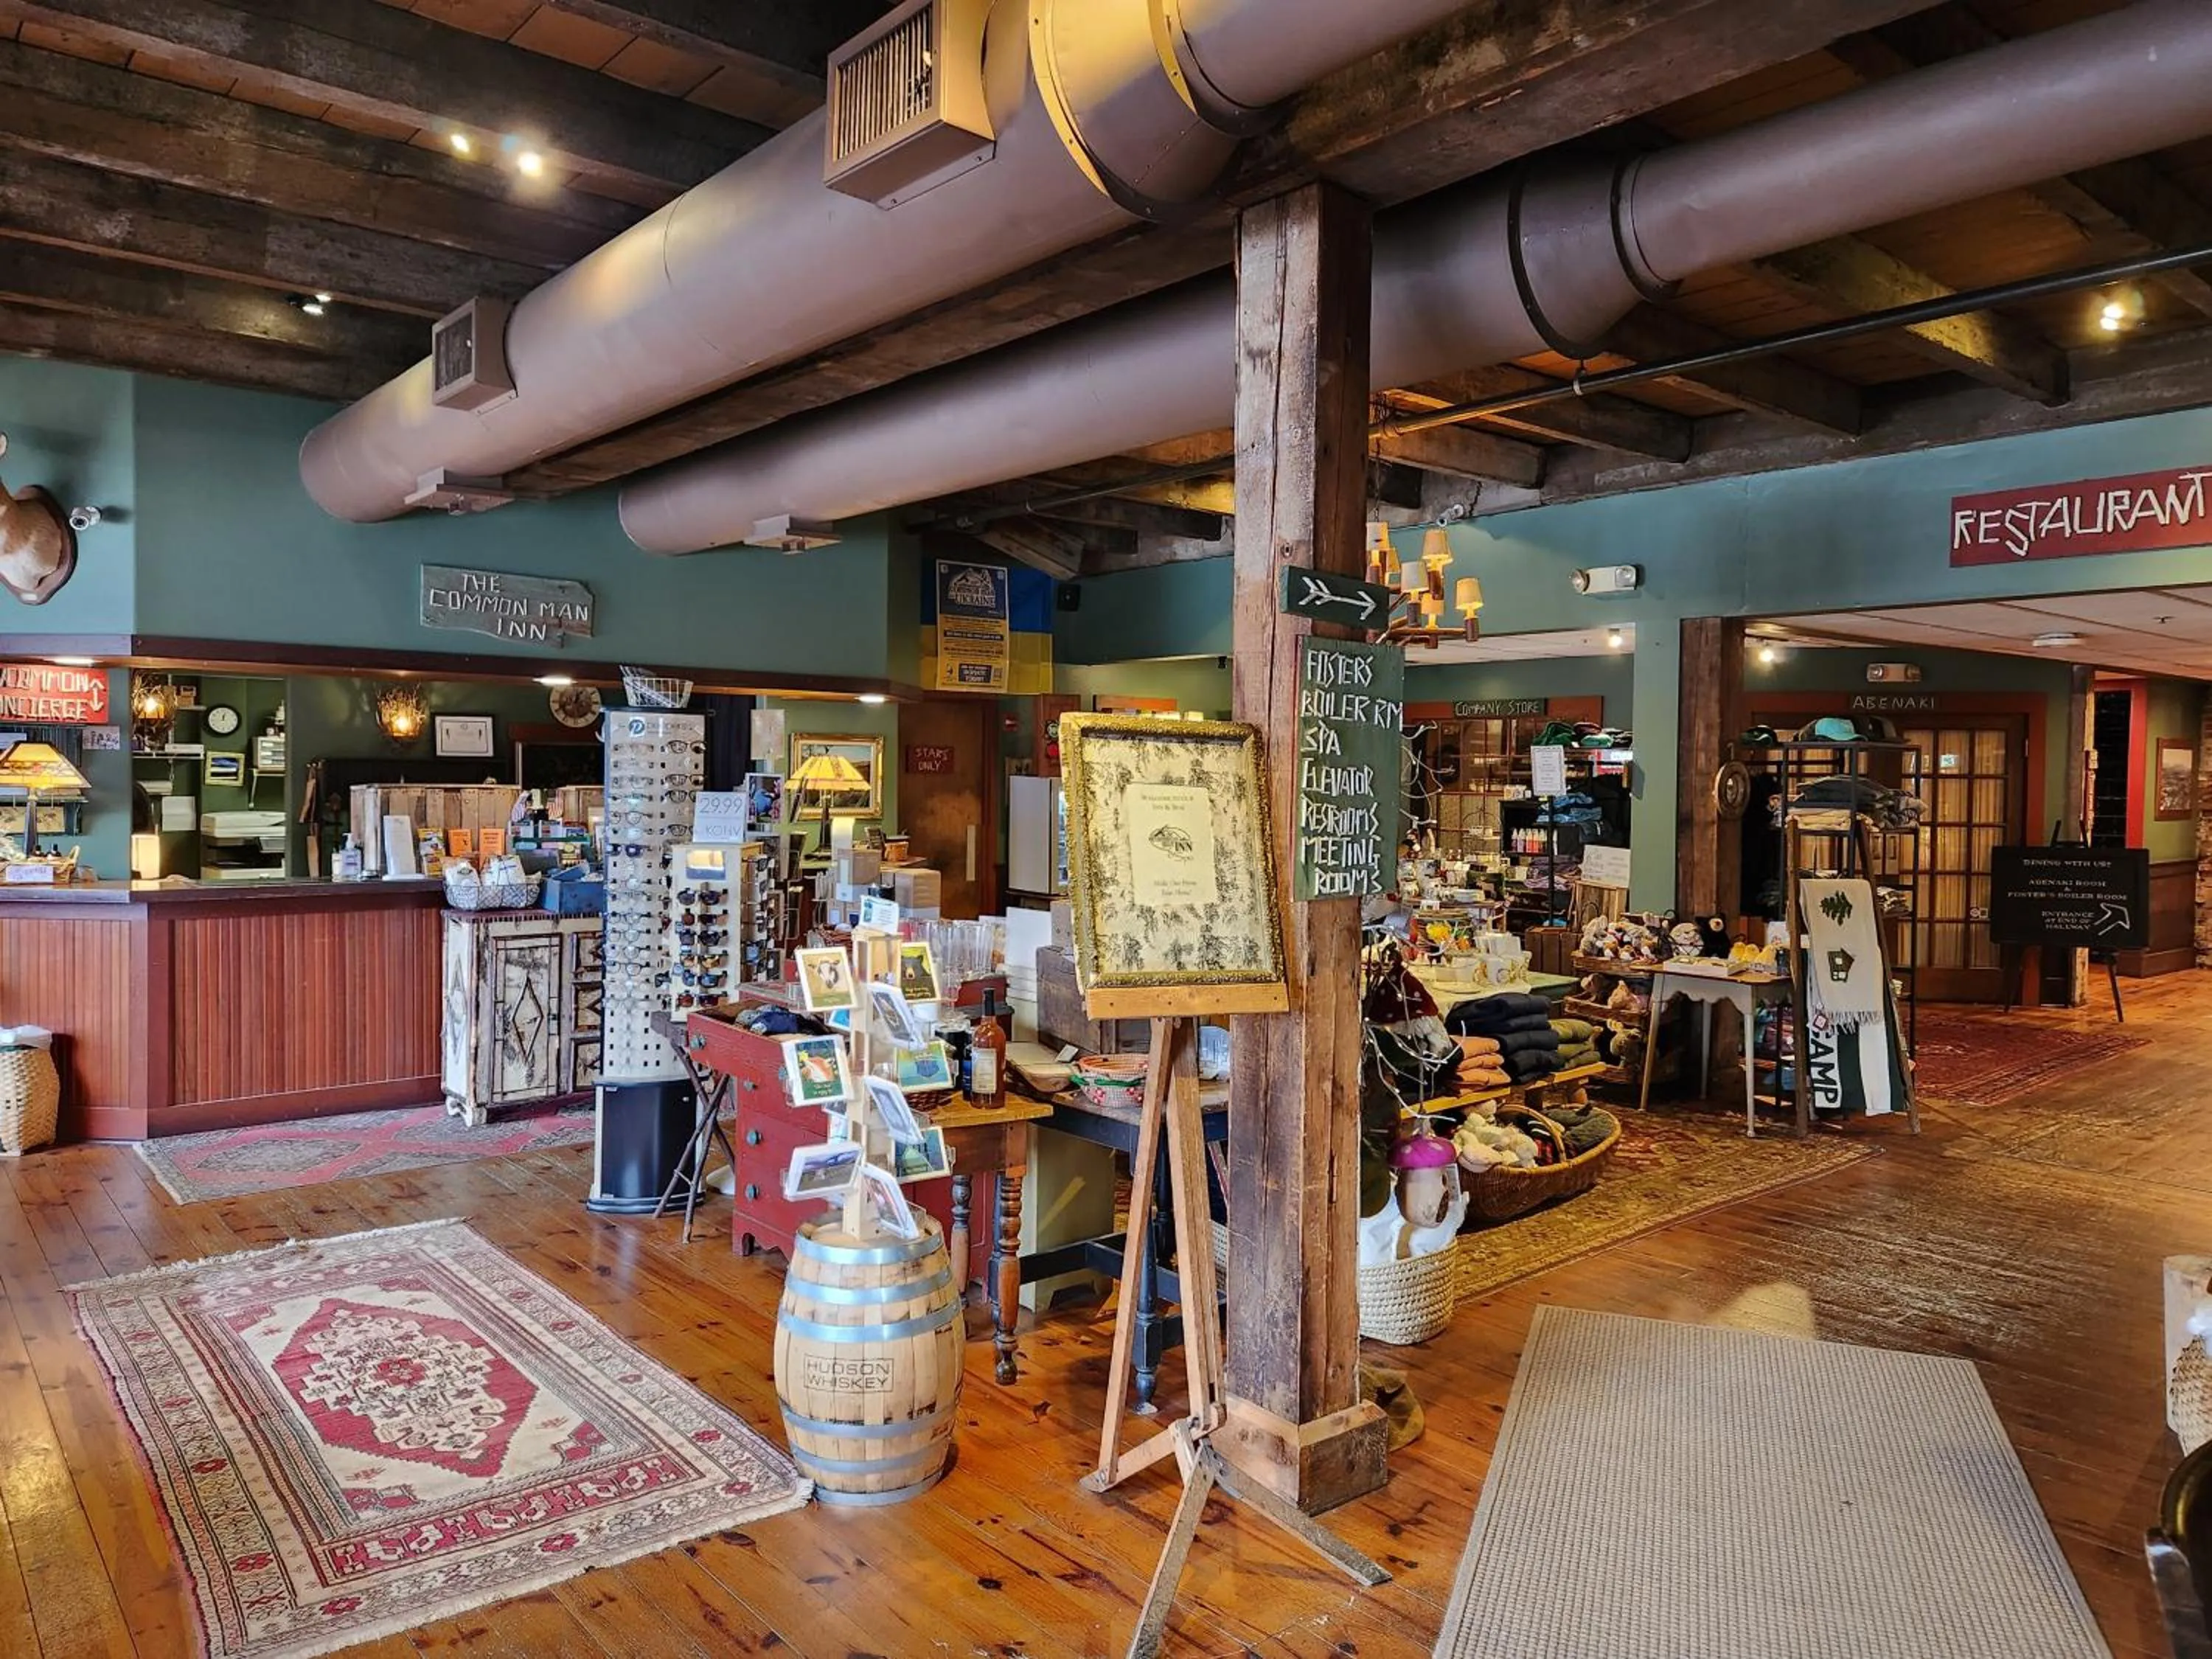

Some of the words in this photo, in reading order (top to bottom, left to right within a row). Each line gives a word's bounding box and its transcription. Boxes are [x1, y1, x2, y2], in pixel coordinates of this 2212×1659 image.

[1953, 472, 2212, 557] RESTAURANT
[462, 573, 501, 594] THE
[429, 588, 529, 616] COMMON
[539, 602, 588, 621] MAN
[497, 617, 547, 641] INN
[1301, 688, 1371, 722] BOILER
[1374, 697, 1403, 732] RM
[1455, 698, 1502, 717] COMPANY
[1507, 700, 1540, 715] STORE
[1852, 695, 1935, 710] ABENAKI
[1300, 719, 1341, 756] SPA
[918, 760, 942, 773] ONLY
[1301, 757, 1374, 798] ELEVATOR
[699, 796, 742, 815] 29.99
[1300, 793, 1380, 837] RESTROOMS
[1301, 834, 1382, 870] MEETING
[1313, 866, 1383, 896] ROOMS
[807, 1359, 891, 1376] HUDSON
[807, 1374, 888, 1389] WHISKEY
